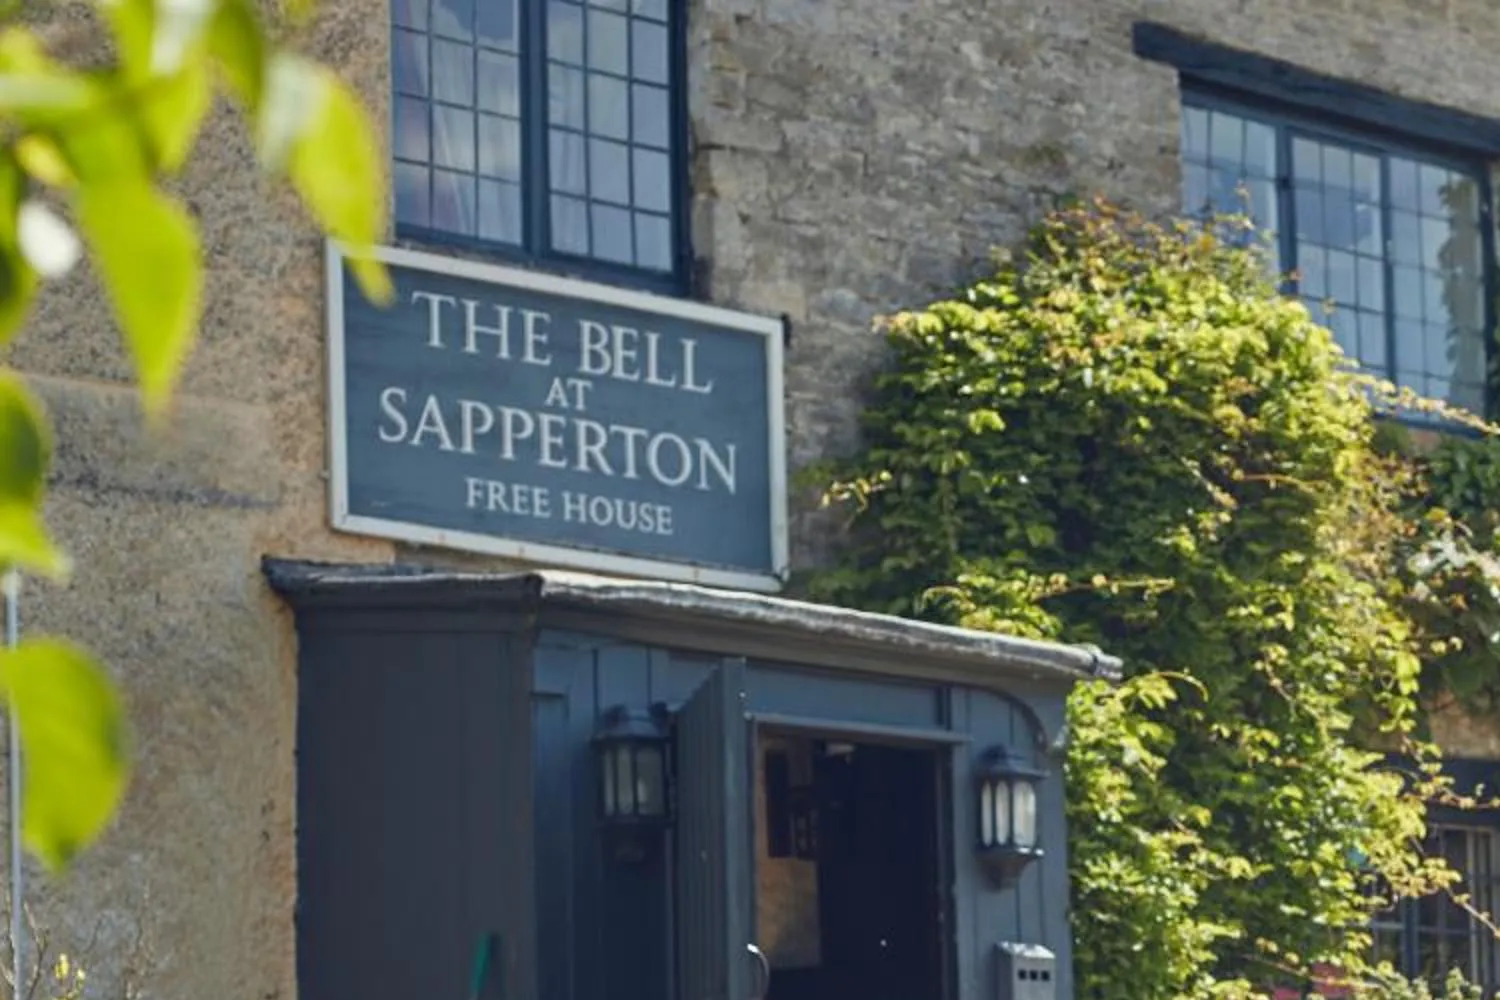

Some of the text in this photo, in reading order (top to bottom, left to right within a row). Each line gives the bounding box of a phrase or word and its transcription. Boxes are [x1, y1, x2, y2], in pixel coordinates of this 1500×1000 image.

[411, 291, 713, 394] THE BELL
[545, 377, 592, 411] AT
[378, 386, 737, 495] SAPPERTON
[465, 477, 673, 535] FREE HOUSE
